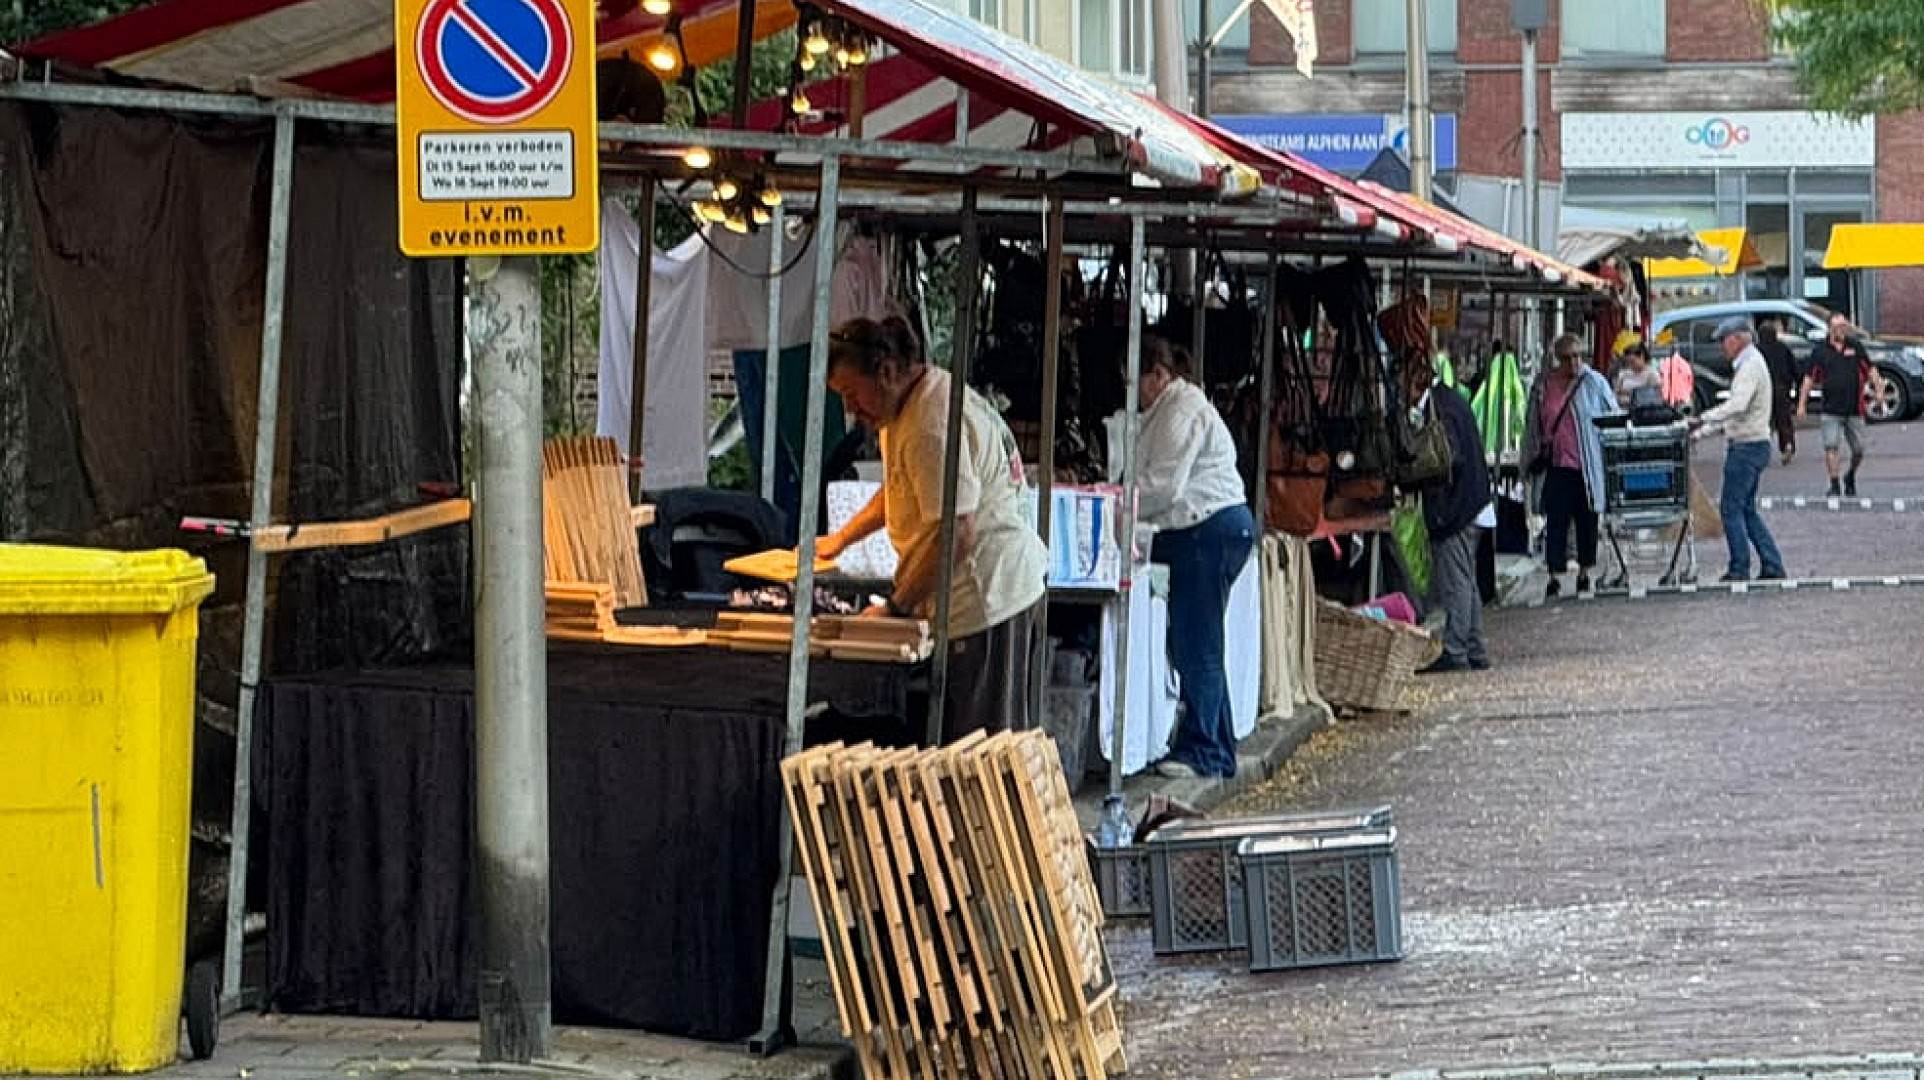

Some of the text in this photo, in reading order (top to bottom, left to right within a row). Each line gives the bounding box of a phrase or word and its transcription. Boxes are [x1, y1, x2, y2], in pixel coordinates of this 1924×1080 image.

[424, 139, 563, 154] Parkeren verboden
[1308, 133, 1351, 151] ALPHEN
[1353, 133, 1377, 151] AAN
[456, 160, 481, 174] Sept
[519, 163, 536, 172] uur
[540, 160, 563, 172] t/m
[432, 176, 452, 188] Wo
[469, 176, 495, 190] Sept
[531, 178, 550, 188] uur
[464, 201, 532, 222] i.v.m.
[429, 225, 565, 246] evenement
